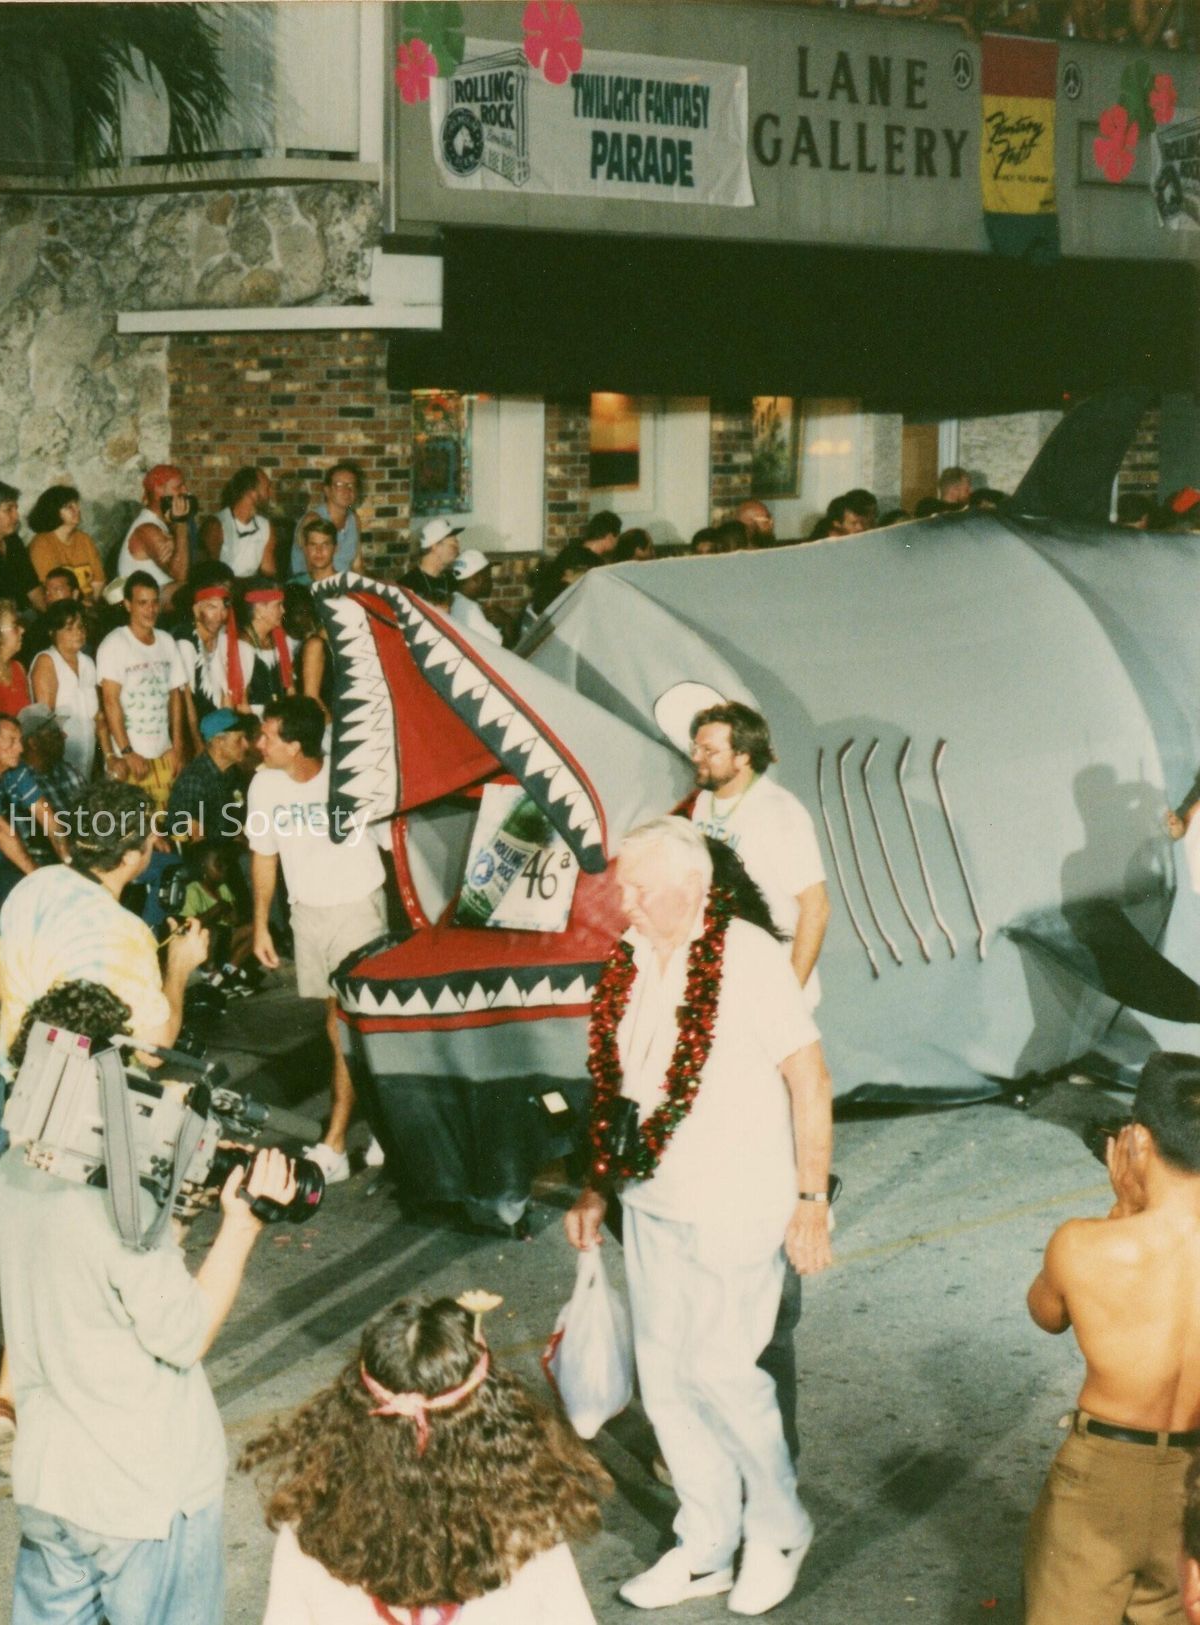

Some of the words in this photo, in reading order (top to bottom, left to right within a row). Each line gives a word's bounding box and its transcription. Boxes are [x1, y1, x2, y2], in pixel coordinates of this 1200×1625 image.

[454, 71, 514, 103] ROLLING
[571, 73, 642, 122] TWILIGHT
[645, 80, 711, 130] FANTASY
[797, 46, 928, 110] LANE
[480, 103, 515, 130] ROCK
[590, 130, 695, 188] PARADE
[752, 113, 970, 179] GALLERY
